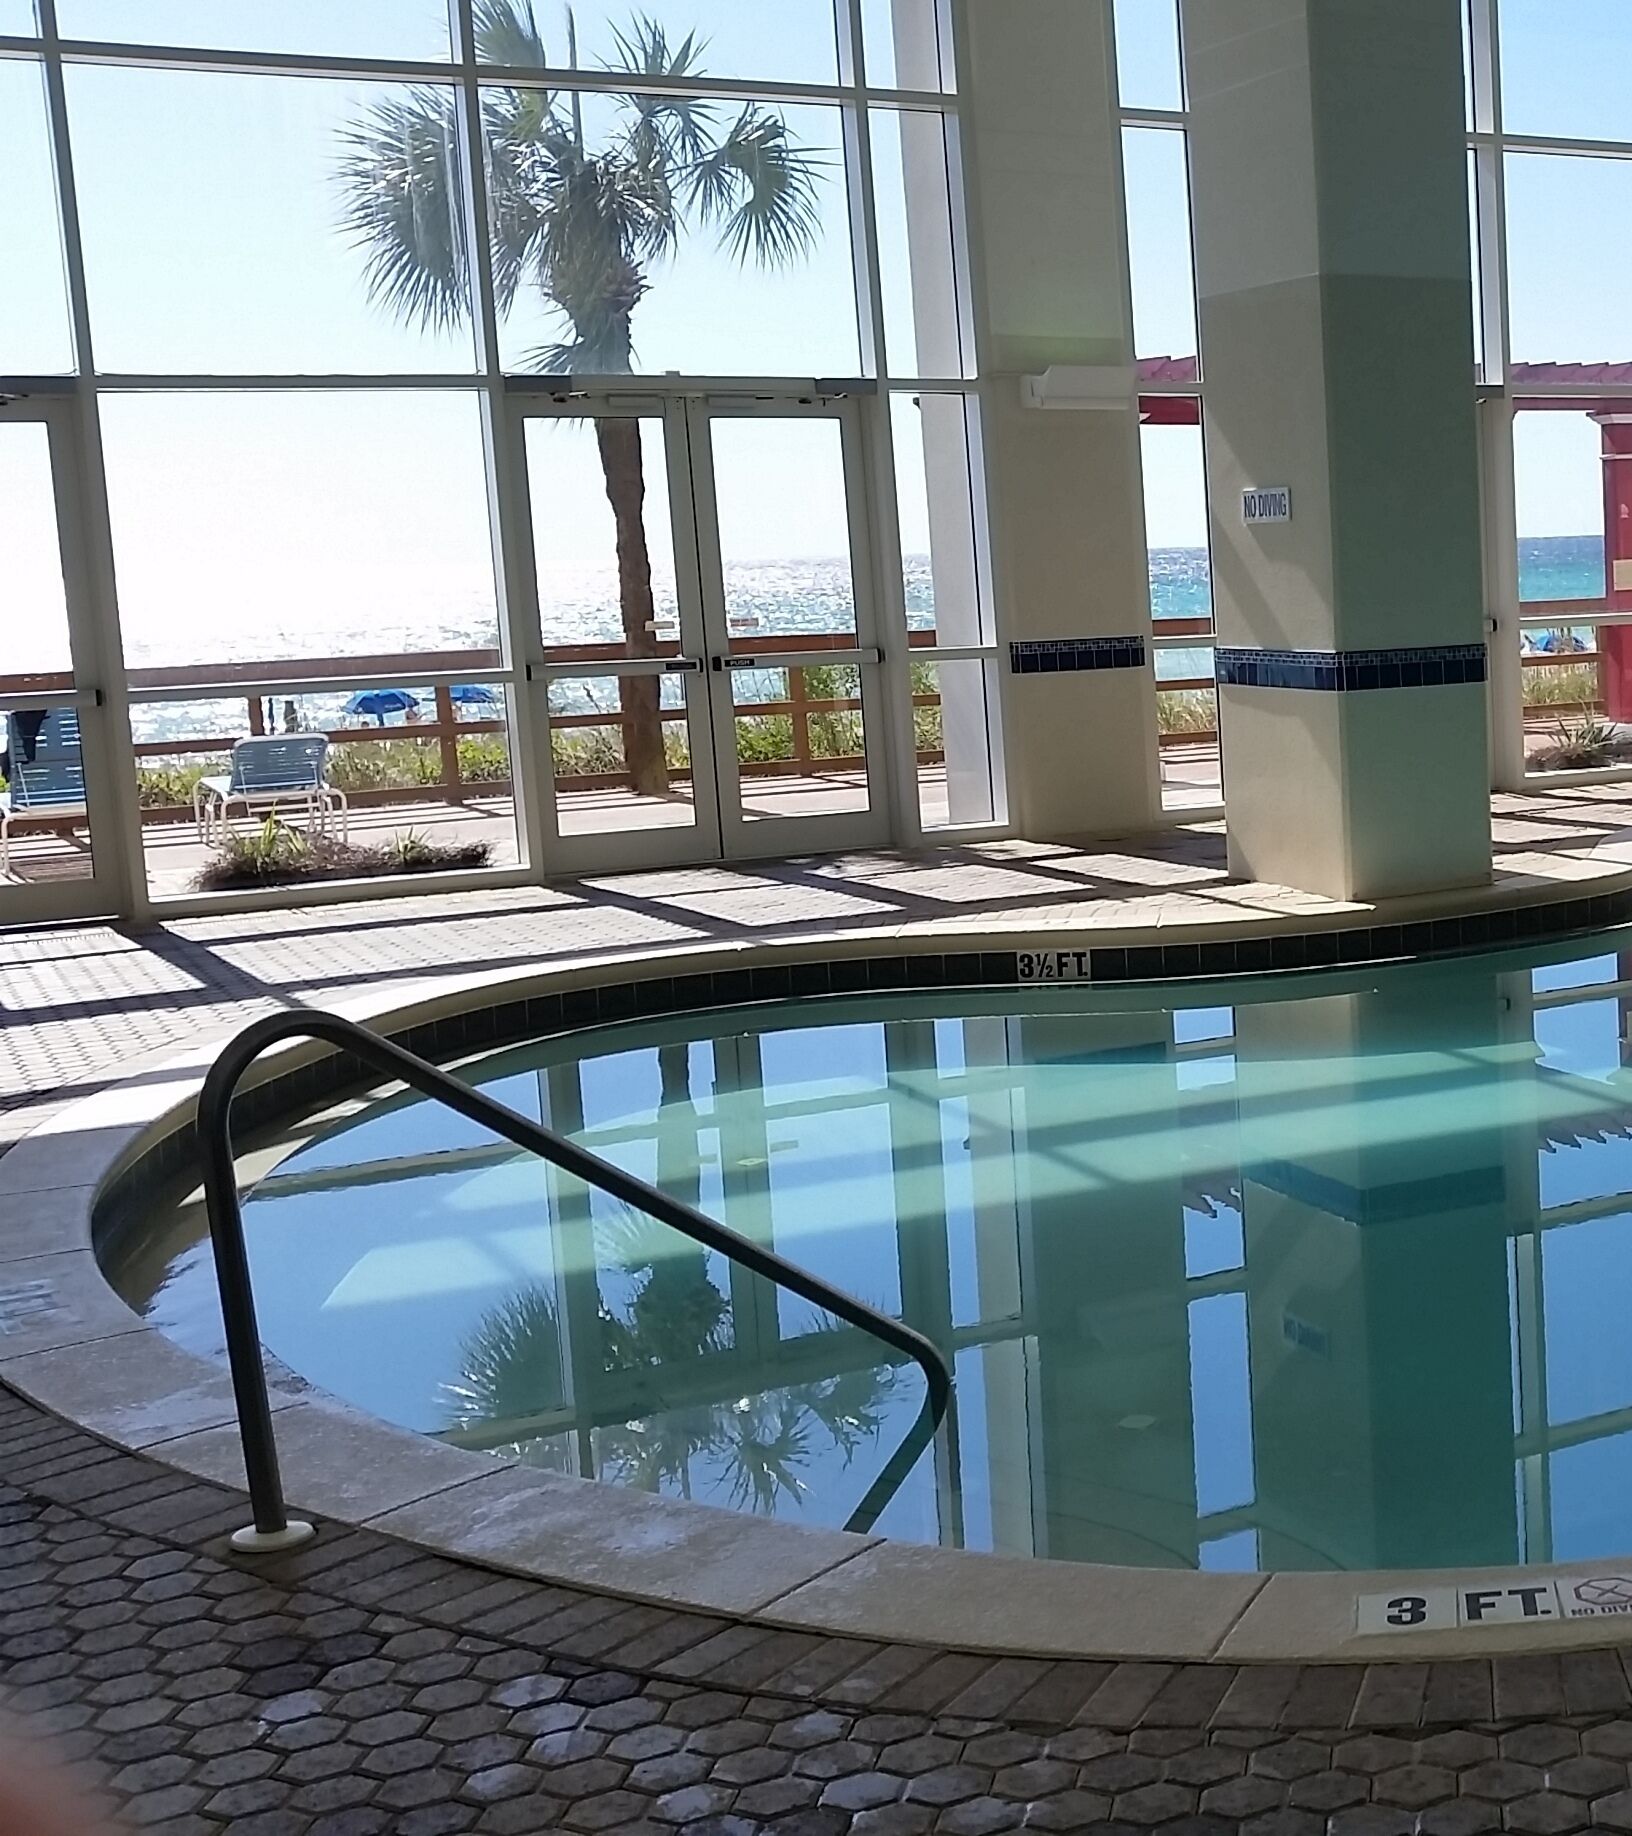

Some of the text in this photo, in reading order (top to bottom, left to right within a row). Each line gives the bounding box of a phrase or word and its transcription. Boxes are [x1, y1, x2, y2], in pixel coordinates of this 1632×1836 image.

[1244, 493, 1287, 518] NO DIVING
[1056, 951, 1088, 978] FT.
[1387, 1587, 1552, 1625] 3 FT.
[1571, 1607, 1595, 1616] NO
